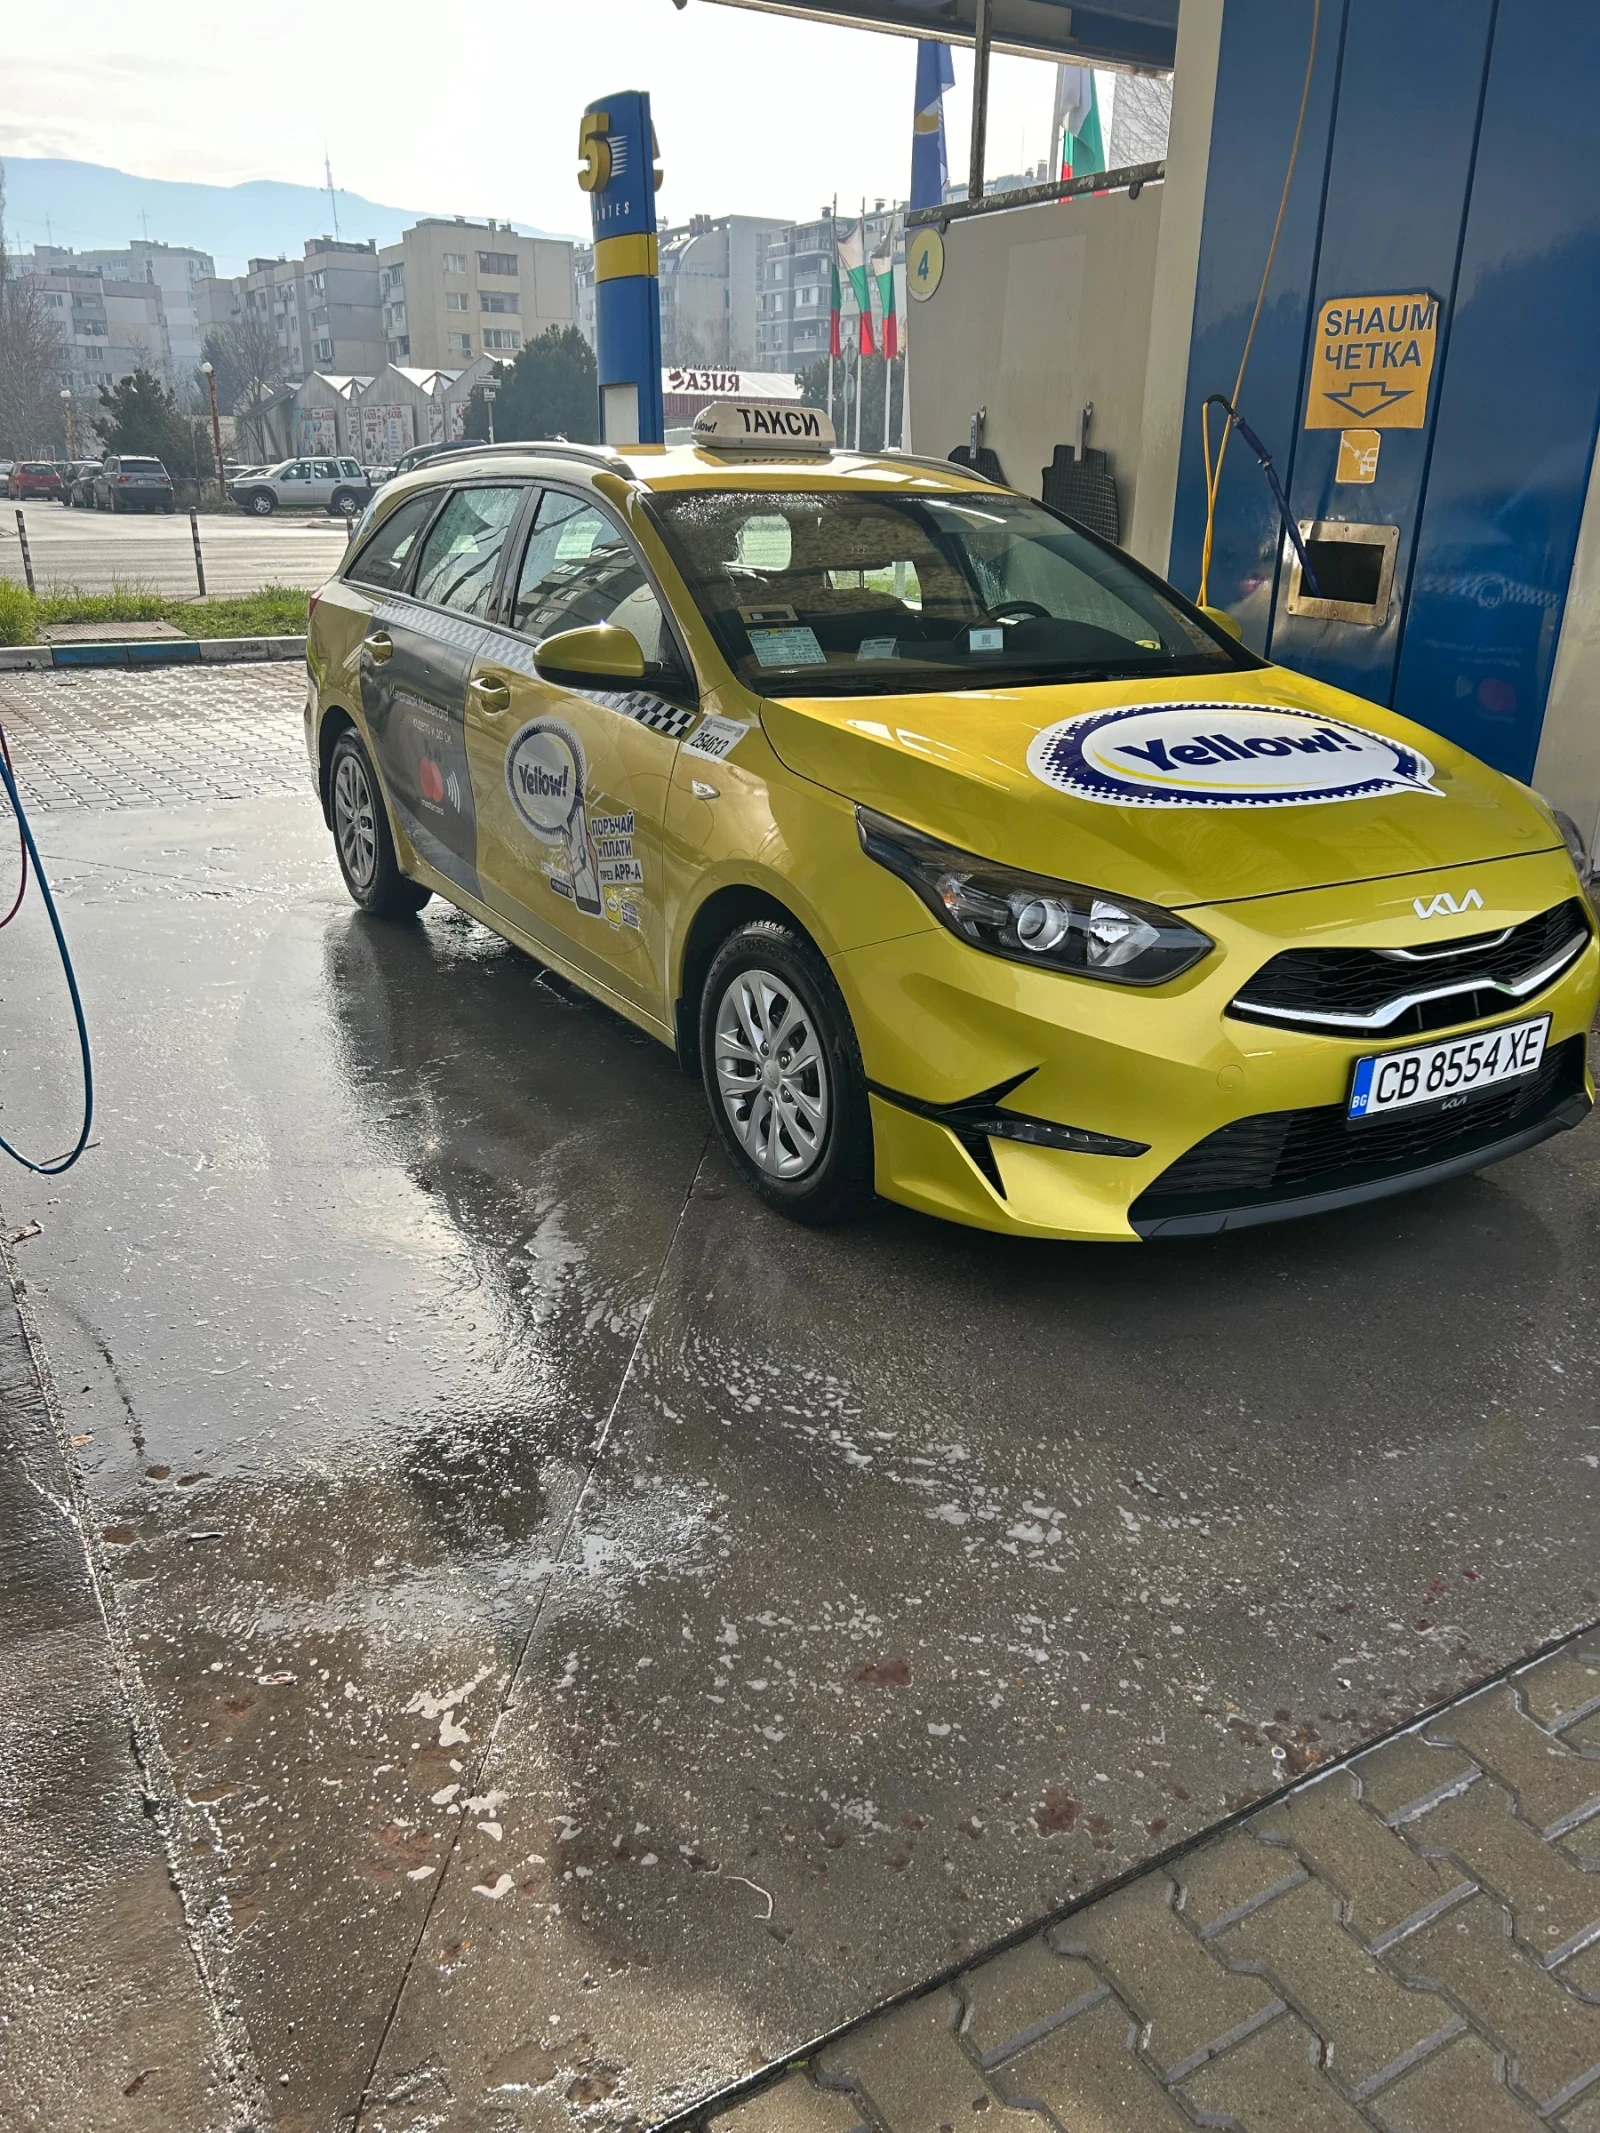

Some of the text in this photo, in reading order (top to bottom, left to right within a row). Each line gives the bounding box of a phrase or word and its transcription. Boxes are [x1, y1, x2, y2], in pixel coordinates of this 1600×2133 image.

[578, 112, 610, 193] 5
[917, 250, 930, 280] 4
[1324, 303, 1435, 336] SHAUM
[693, 364, 737, 373] МАГАЗИН
[1325, 340, 1422, 370] ЧЕТКА
[685, 372, 740, 392] АЗИЯ
[736, 408, 820, 437] ТАКСИ
[690, 732, 730, 756] 254613
[1113, 727, 1363, 772] Yellow!
[518, 763, 569, 798] Yellow!
[591, 811, 634, 836] ПОРЪЧАЙ
[603, 839, 632, 857] ПЛАТИ
[1412, 888, 1484, 920] KIA
[1376, 1024, 1543, 1104] CB 8554 XE
[1351, 1094, 1368, 1109] BG
